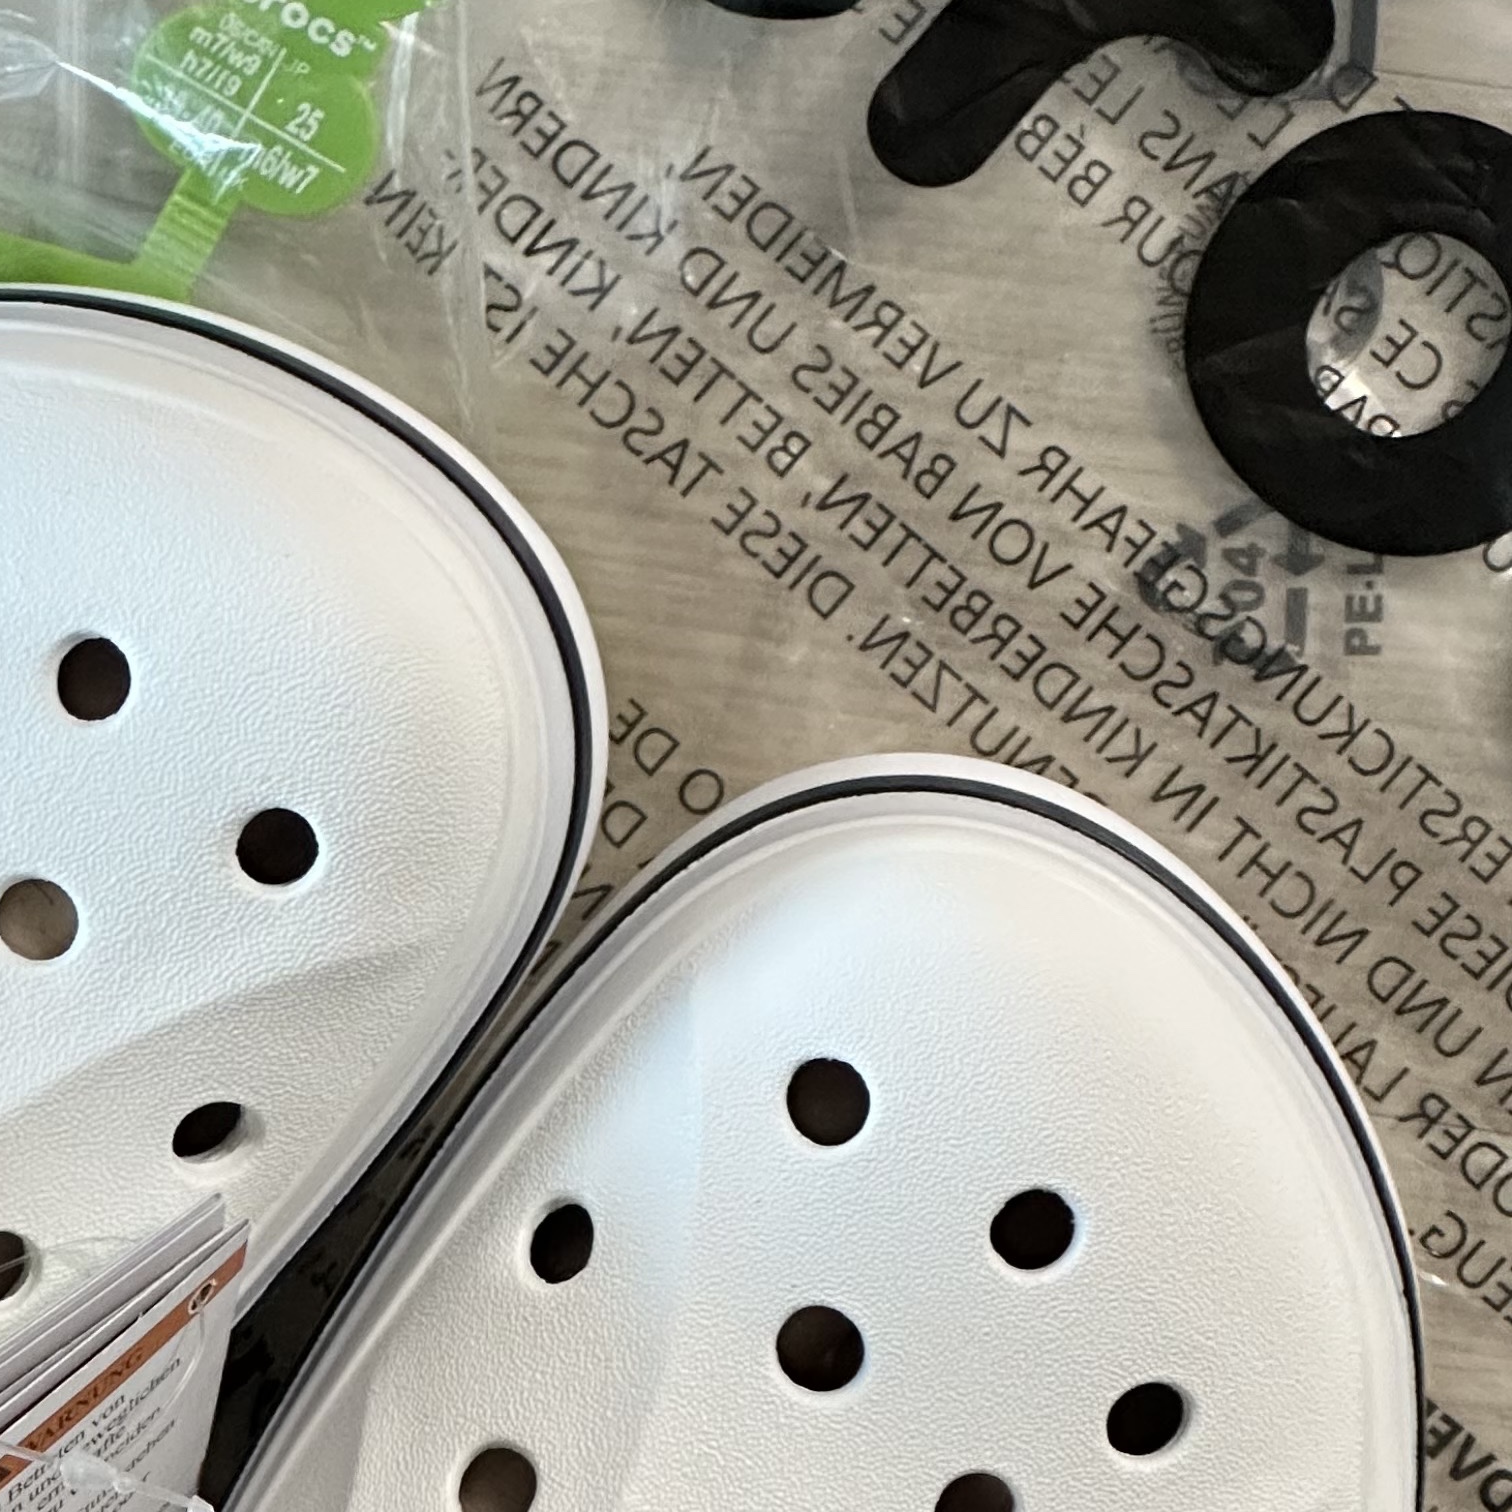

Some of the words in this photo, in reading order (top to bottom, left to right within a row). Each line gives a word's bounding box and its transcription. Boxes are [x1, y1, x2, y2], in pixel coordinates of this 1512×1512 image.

[189, 26, 262, 75] m7/w9
[285, 102, 325, 142] 25
[25, 1345, 143, 1448] WARNUNG
[91, 1395, 125, 1427] von
